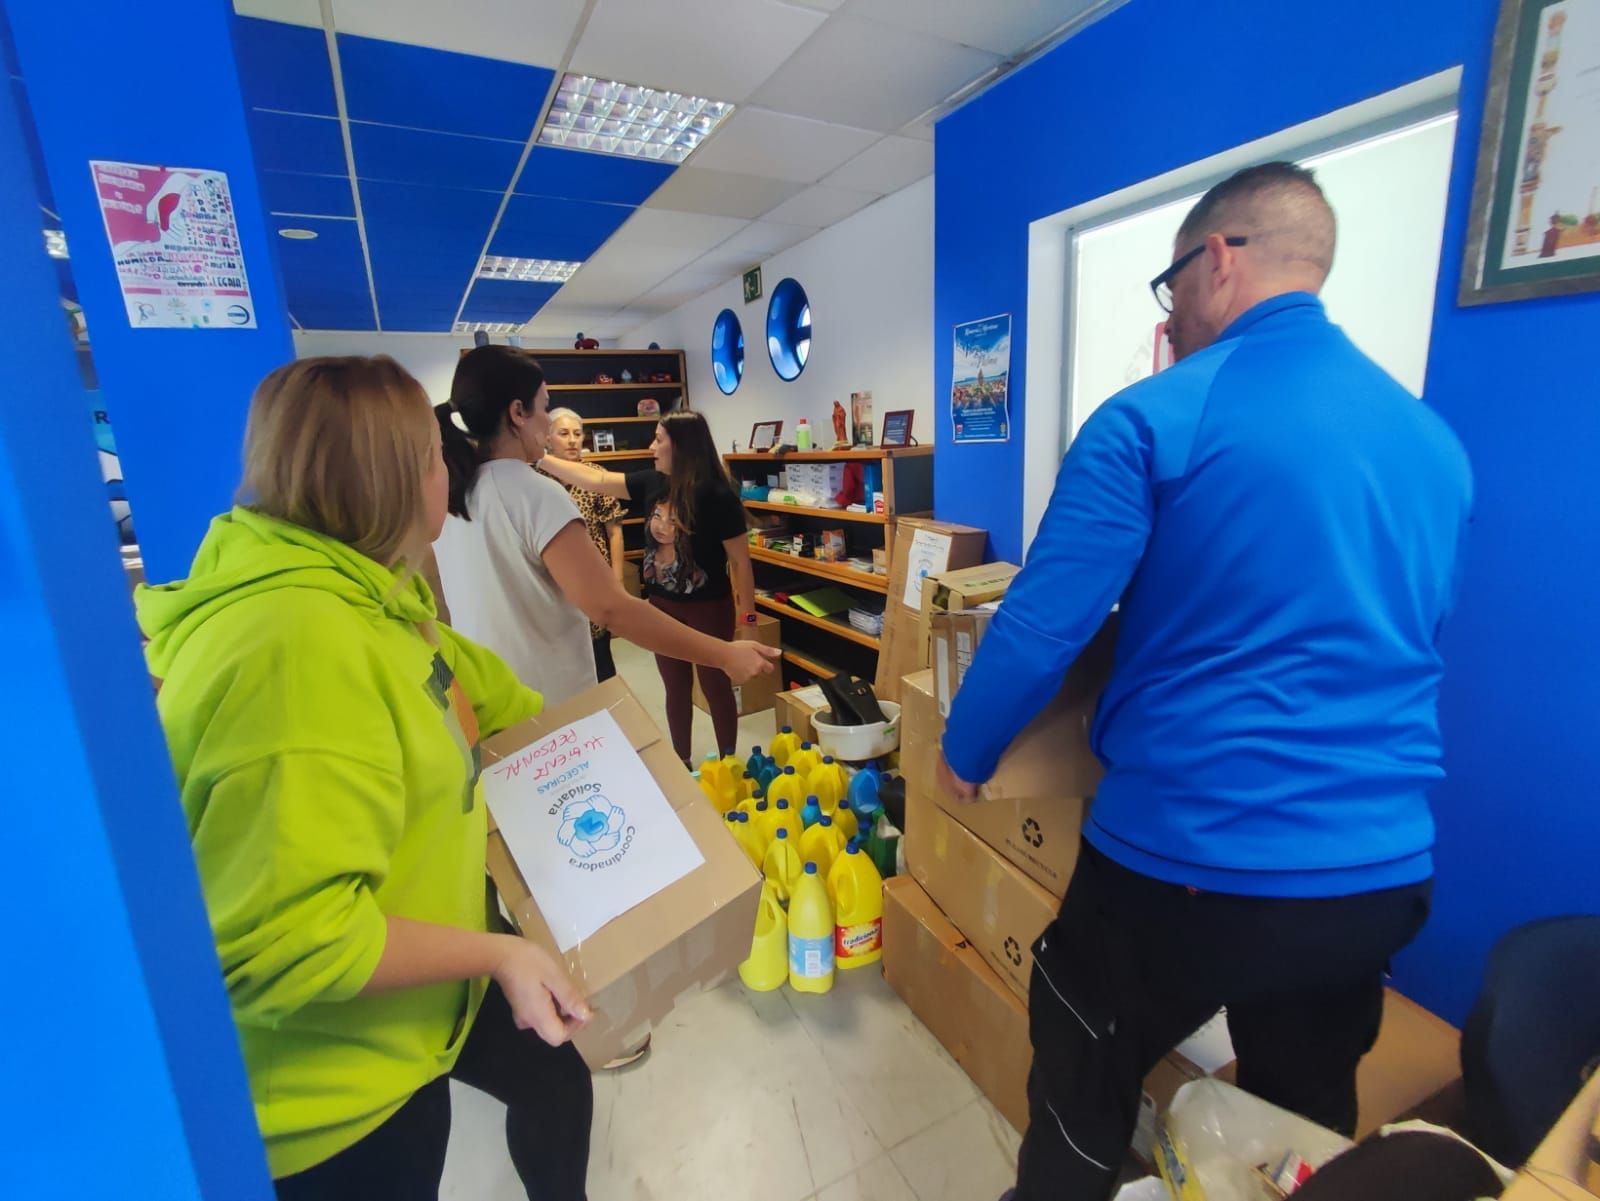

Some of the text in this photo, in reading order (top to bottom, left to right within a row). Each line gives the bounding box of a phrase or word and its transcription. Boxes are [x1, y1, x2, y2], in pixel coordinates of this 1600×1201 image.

[537, 760, 590, 795] ALGECIRAS
[548, 783, 602, 816] Solidaria
[568, 825, 636, 872] Coordinadora
